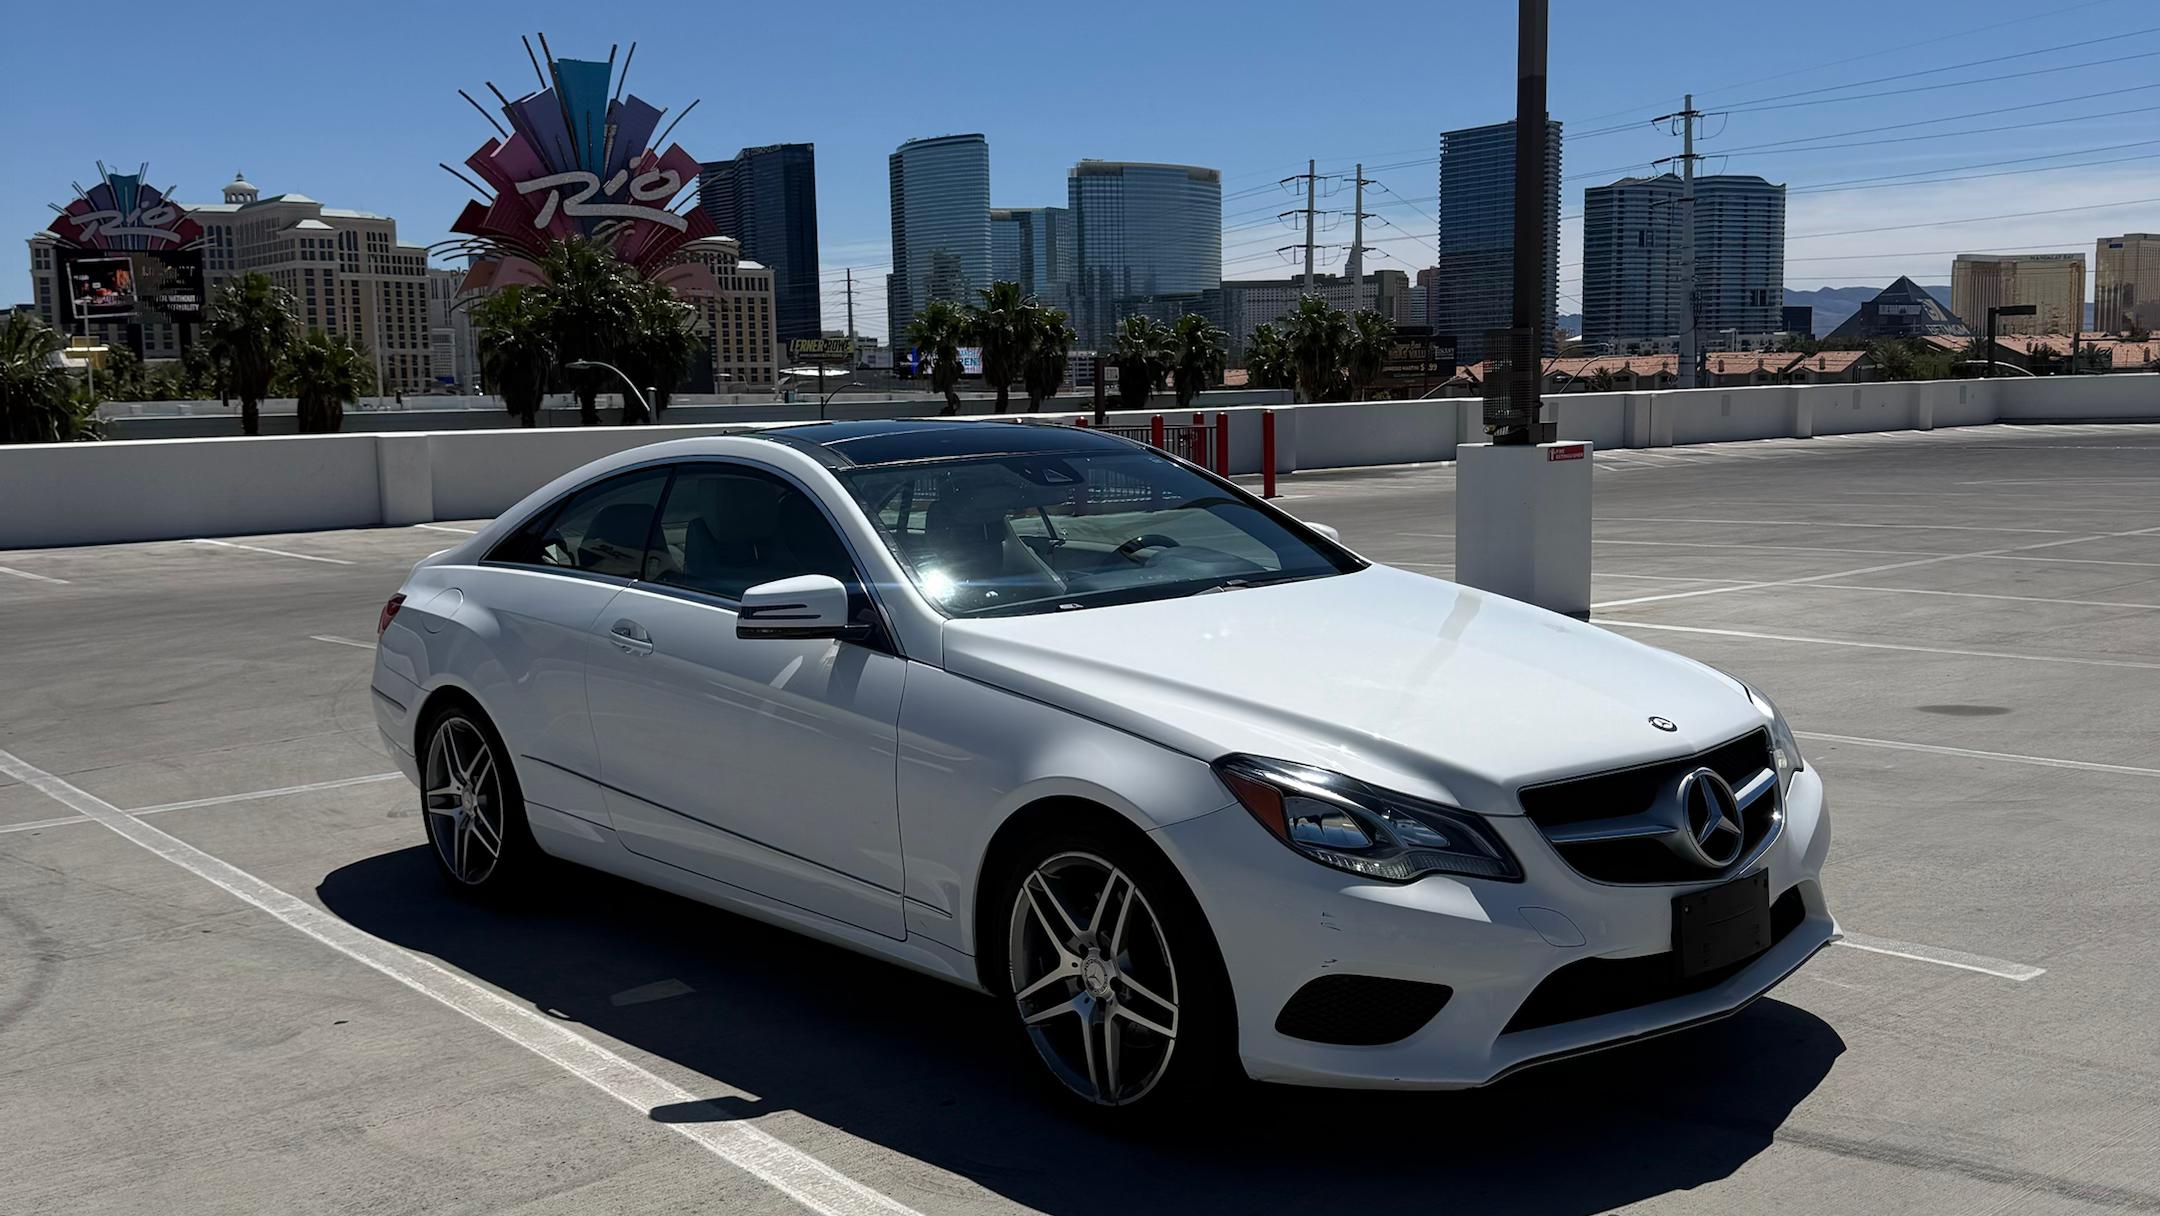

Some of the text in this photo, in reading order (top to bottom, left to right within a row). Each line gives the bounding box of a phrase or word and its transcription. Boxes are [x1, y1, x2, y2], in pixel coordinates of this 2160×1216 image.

[515, 156, 688, 234] Rio
[69, 201, 182, 243] Rio
[789, 339, 824, 352] LERNER
